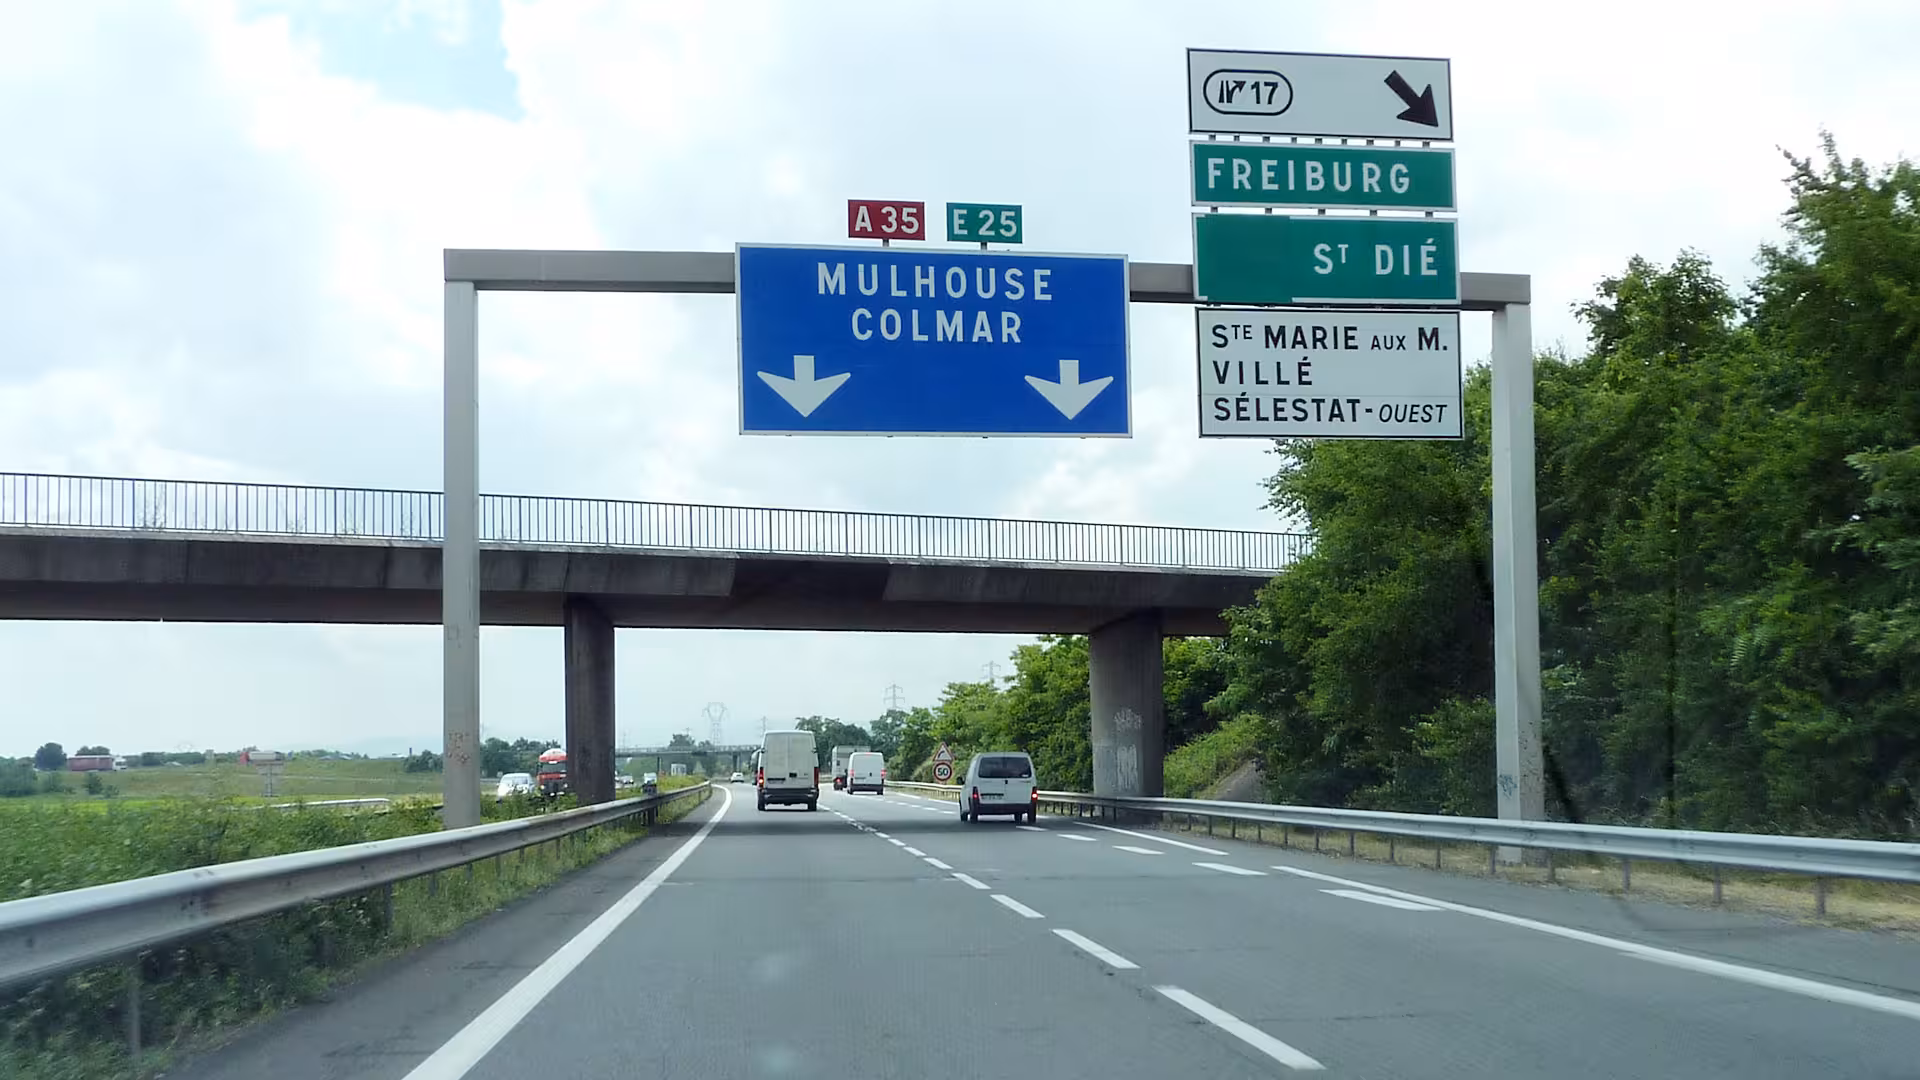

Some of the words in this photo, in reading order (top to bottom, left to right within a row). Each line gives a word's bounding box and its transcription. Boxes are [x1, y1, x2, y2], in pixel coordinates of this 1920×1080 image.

[1250, 81, 1278, 104] 17
[1208, 158, 1410, 193] FREIBURG
[854, 206, 873, 232] A
[881, 206, 920, 234] 35
[953, 209, 968, 235] E
[978, 210, 1017, 237] 25
[1313, 243, 1349, 275] ST
[1375, 238, 1438, 276] DIÉ
[817, 262, 1053, 301] MULHOUSE
[851, 308, 1022, 343] COLMAR
[1212, 324, 1252, 348] STE
[1264, 325, 1359, 350] MARIE
[1371, 335, 1406, 350] AUX
[1418, 327, 1448, 351] M.
[1212, 356, 1313, 386] VILLÉ
[938, 768, 949, 776] 50
